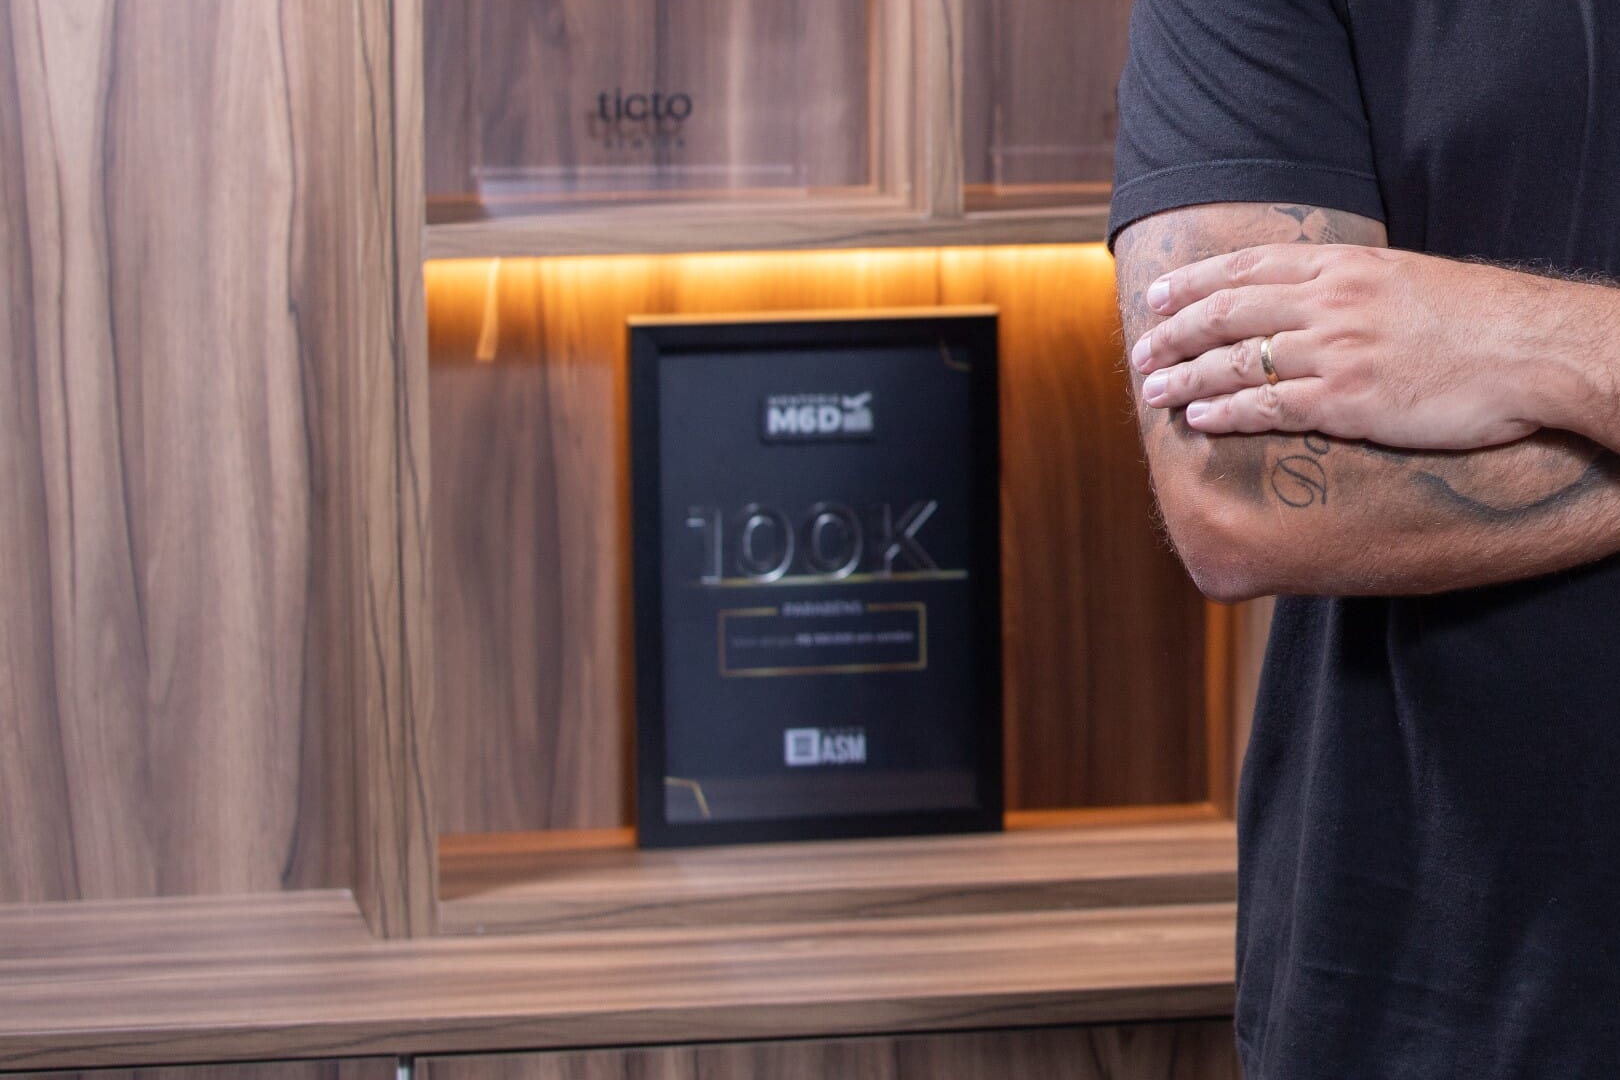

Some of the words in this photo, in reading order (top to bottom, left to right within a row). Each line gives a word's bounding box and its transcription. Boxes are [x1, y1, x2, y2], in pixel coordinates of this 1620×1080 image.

[598, 87, 692, 121] ticto
[686, 501, 940, 585] 100K
[822, 734, 866, 763] ASM
